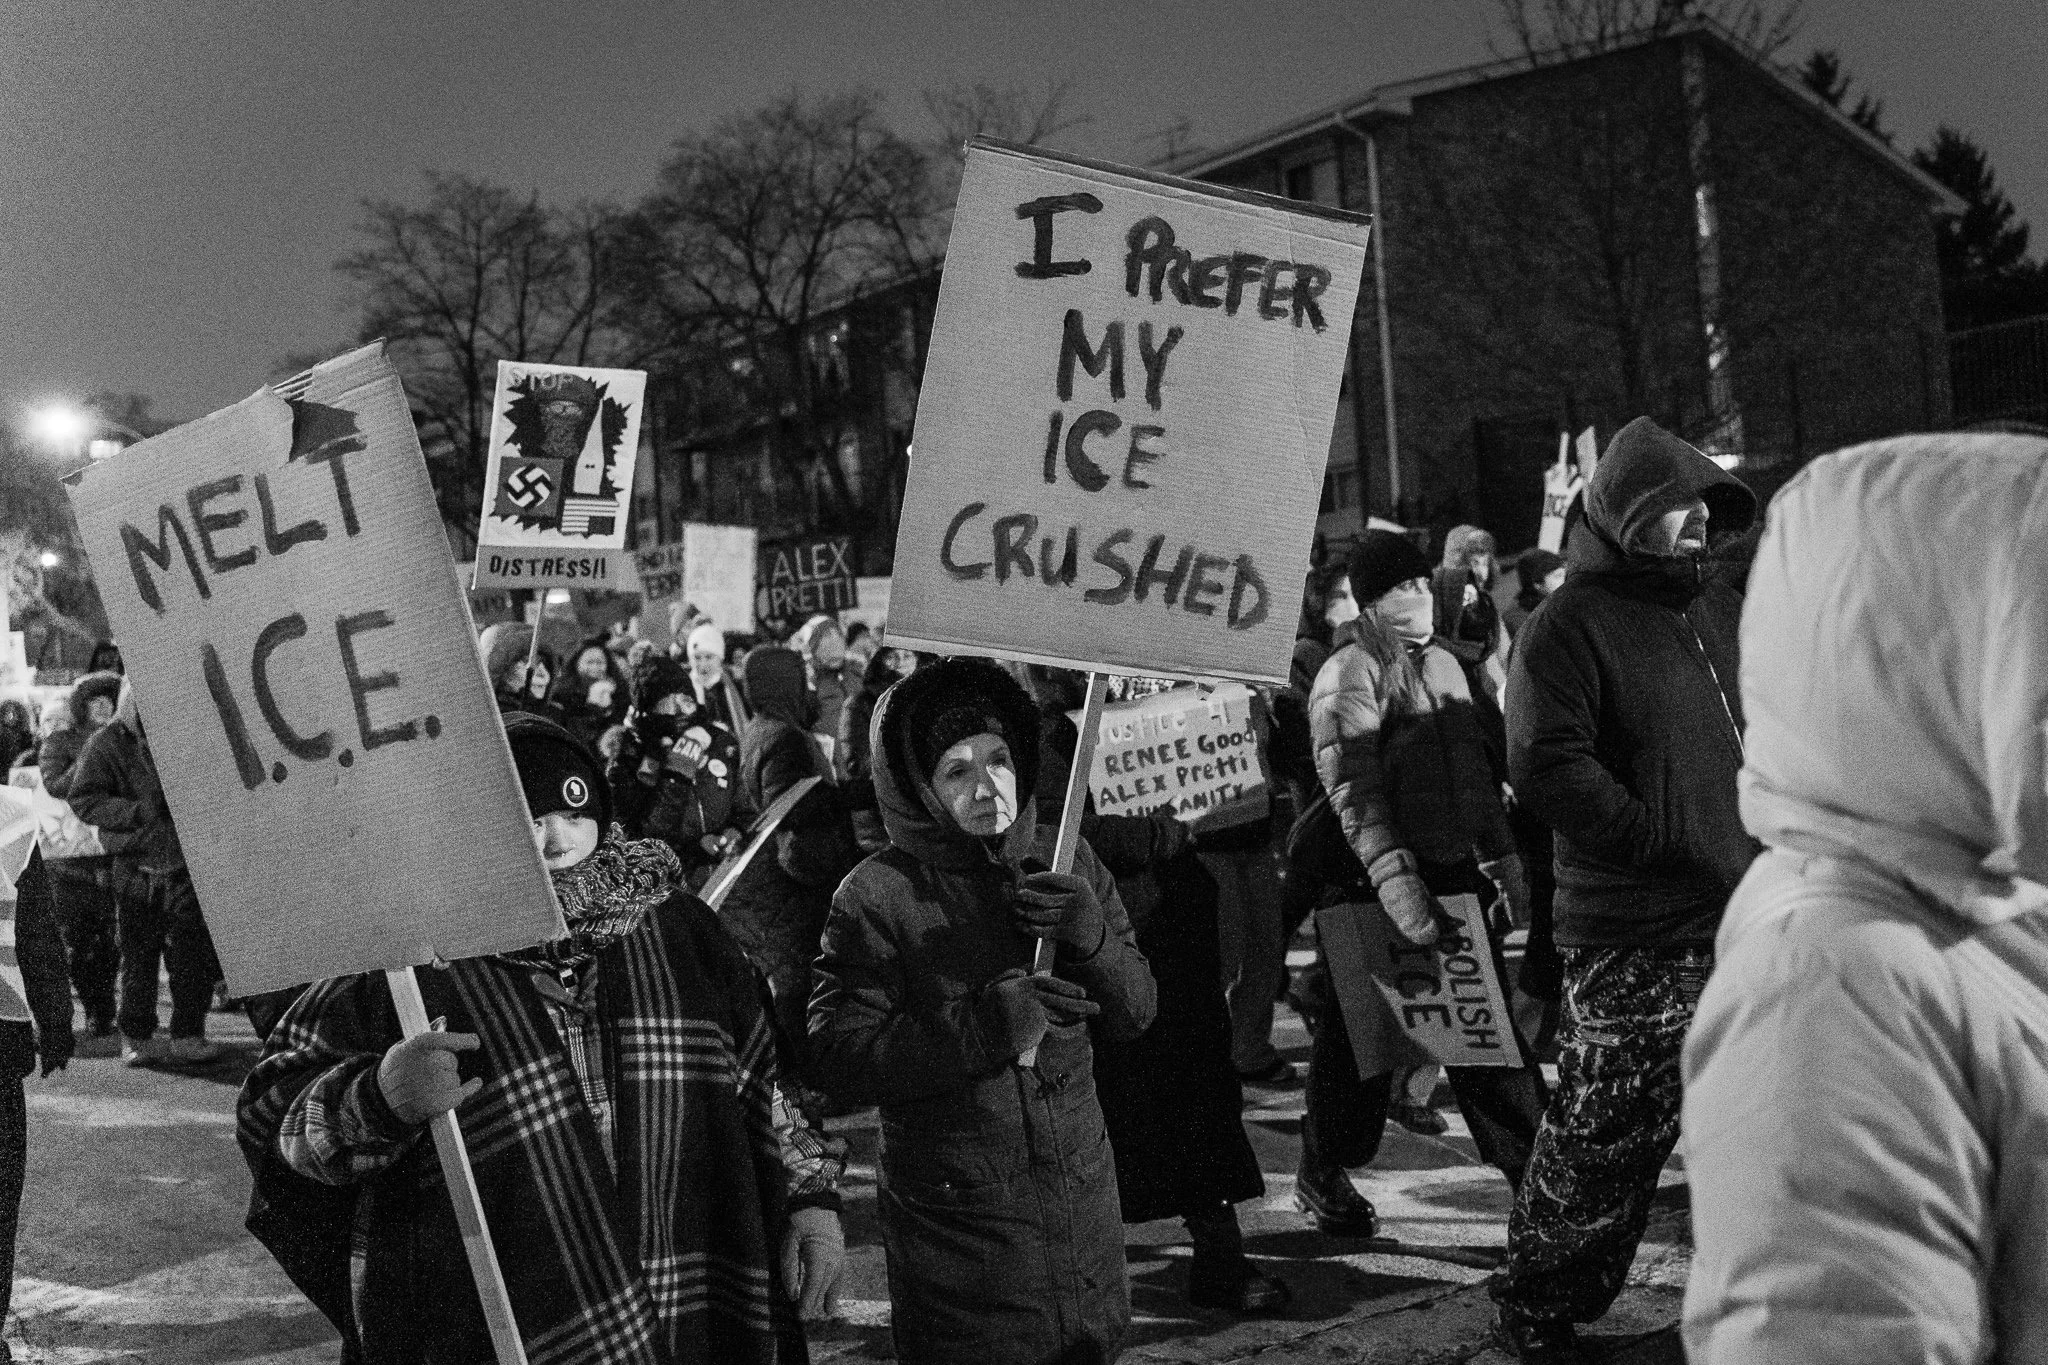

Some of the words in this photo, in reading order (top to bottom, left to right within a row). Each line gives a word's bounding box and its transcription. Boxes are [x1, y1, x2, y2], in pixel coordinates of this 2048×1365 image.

[1014, 192, 1104, 279] I
[1123, 215, 1333, 334] PREFER
[1056, 308, 1185, 411] MY
[1043, 409, 1166, 492] ICE
[119, 432, 368, 618] MELT
[489, 554, 606, 580] DISTRESS!!
[771, 536, 851, 586] ALEX
[940, 501, 1271, 630] CRUSHED
[771, 576, 855, 616] PRETTI
[201, 609, 442, 791] I.C.E.
[1100, 774, 1168, 807] ALEX
[1104, 737, 1191, 777] RENEE
[1388, 941, 1452, 1029] ICE
